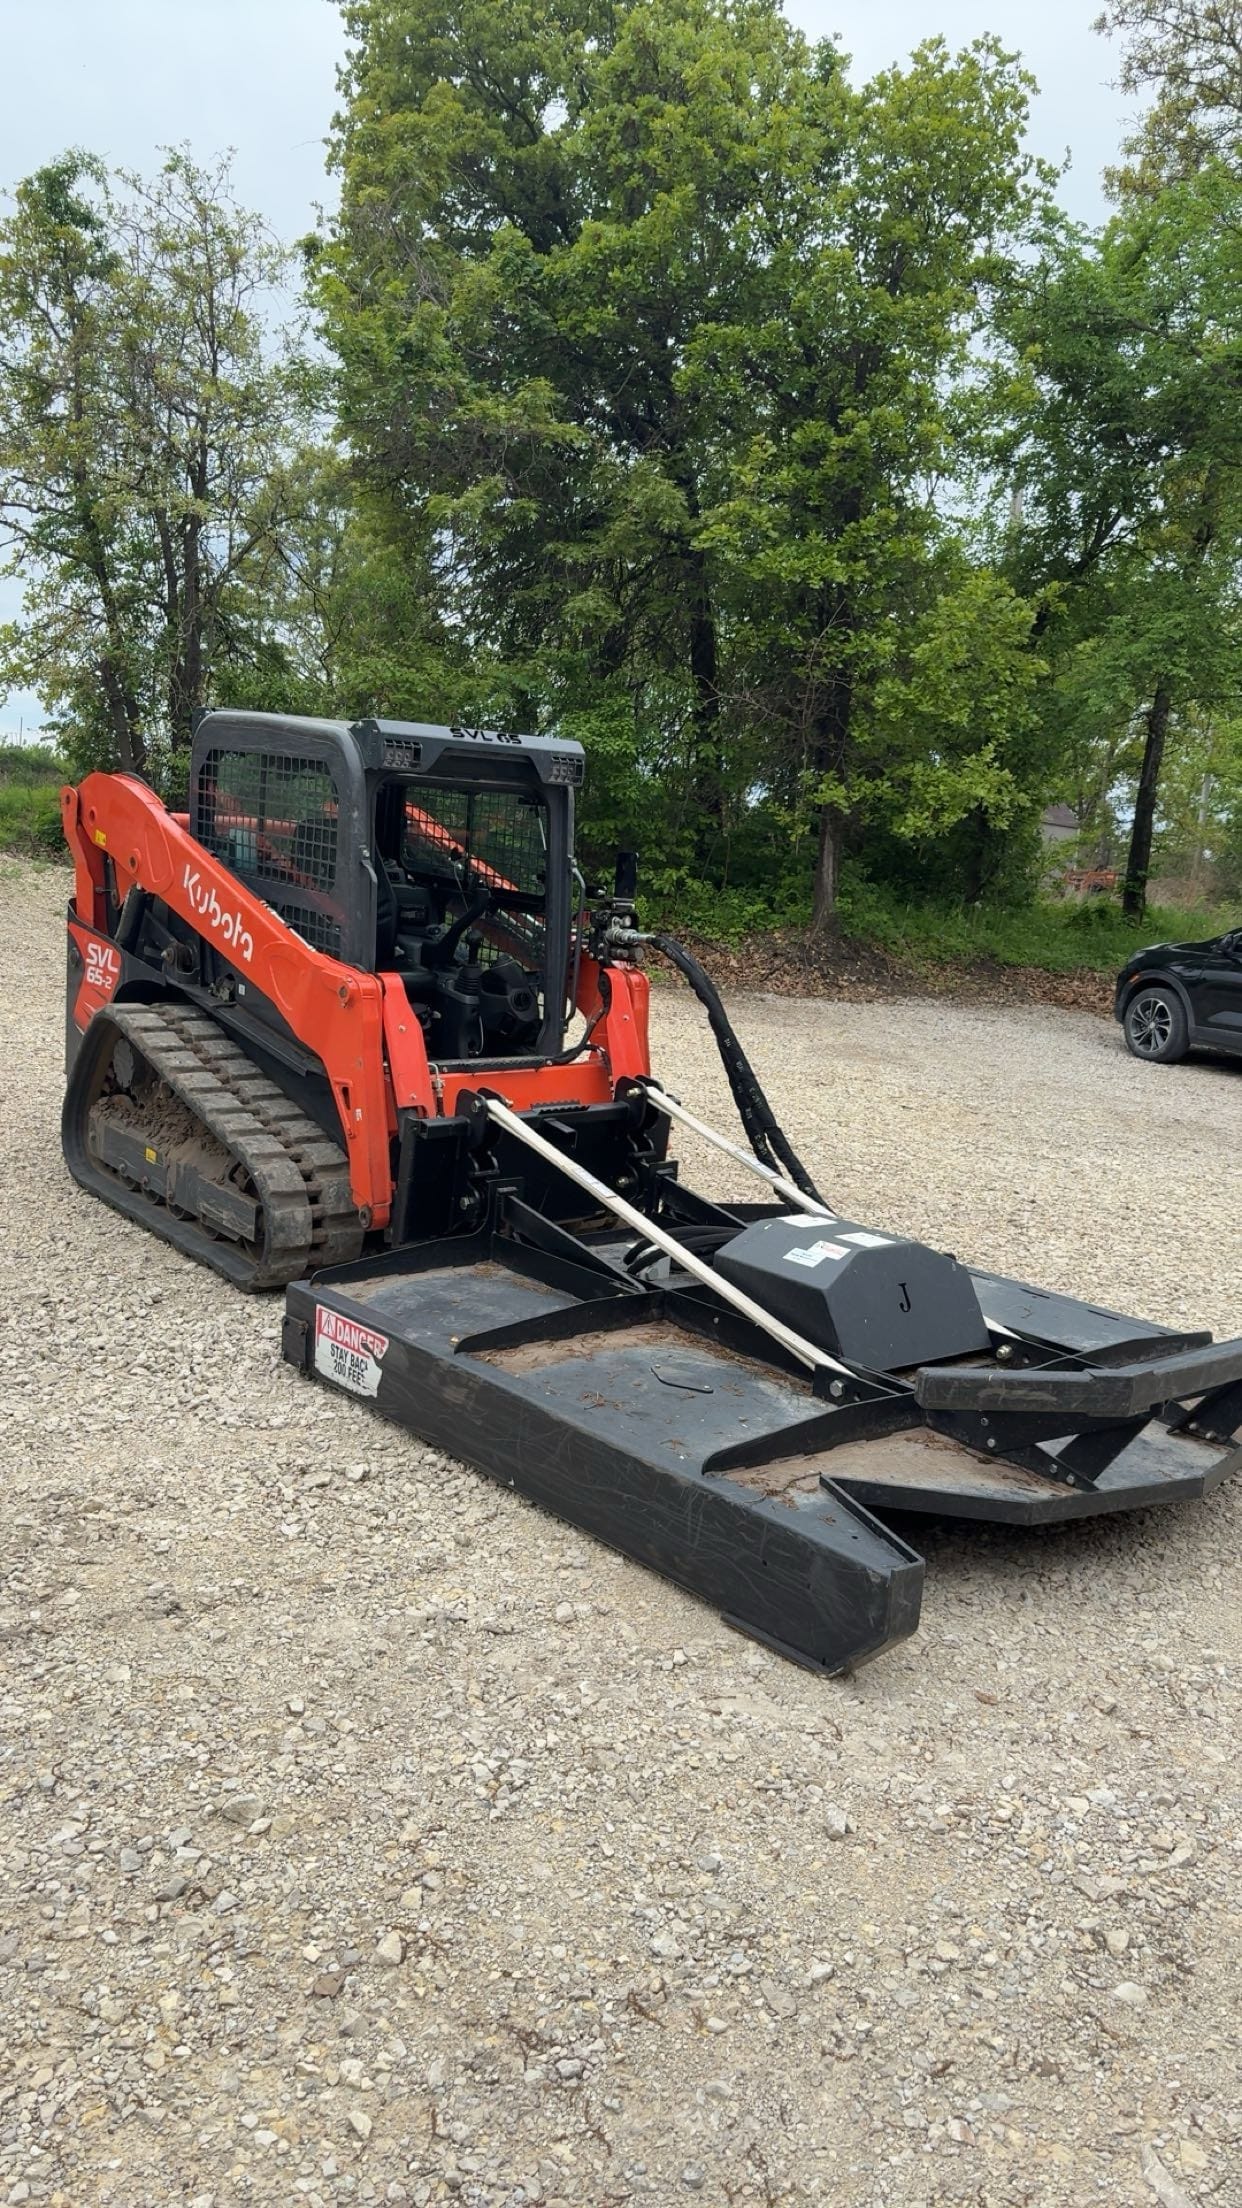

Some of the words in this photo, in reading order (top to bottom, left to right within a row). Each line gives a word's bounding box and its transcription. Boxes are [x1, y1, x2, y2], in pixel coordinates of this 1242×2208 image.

[450, 728, 493, 742] SVL
[184, 864, 253, 962] Kubota
[86, 943, 119, 973] SVL
[87, 966, 112, 990] 65-2
[898, 1282, 911, 1313] J
[331, 1343, 348, 1363] STAY
[336, 1319, 384, 1357] DANGER
